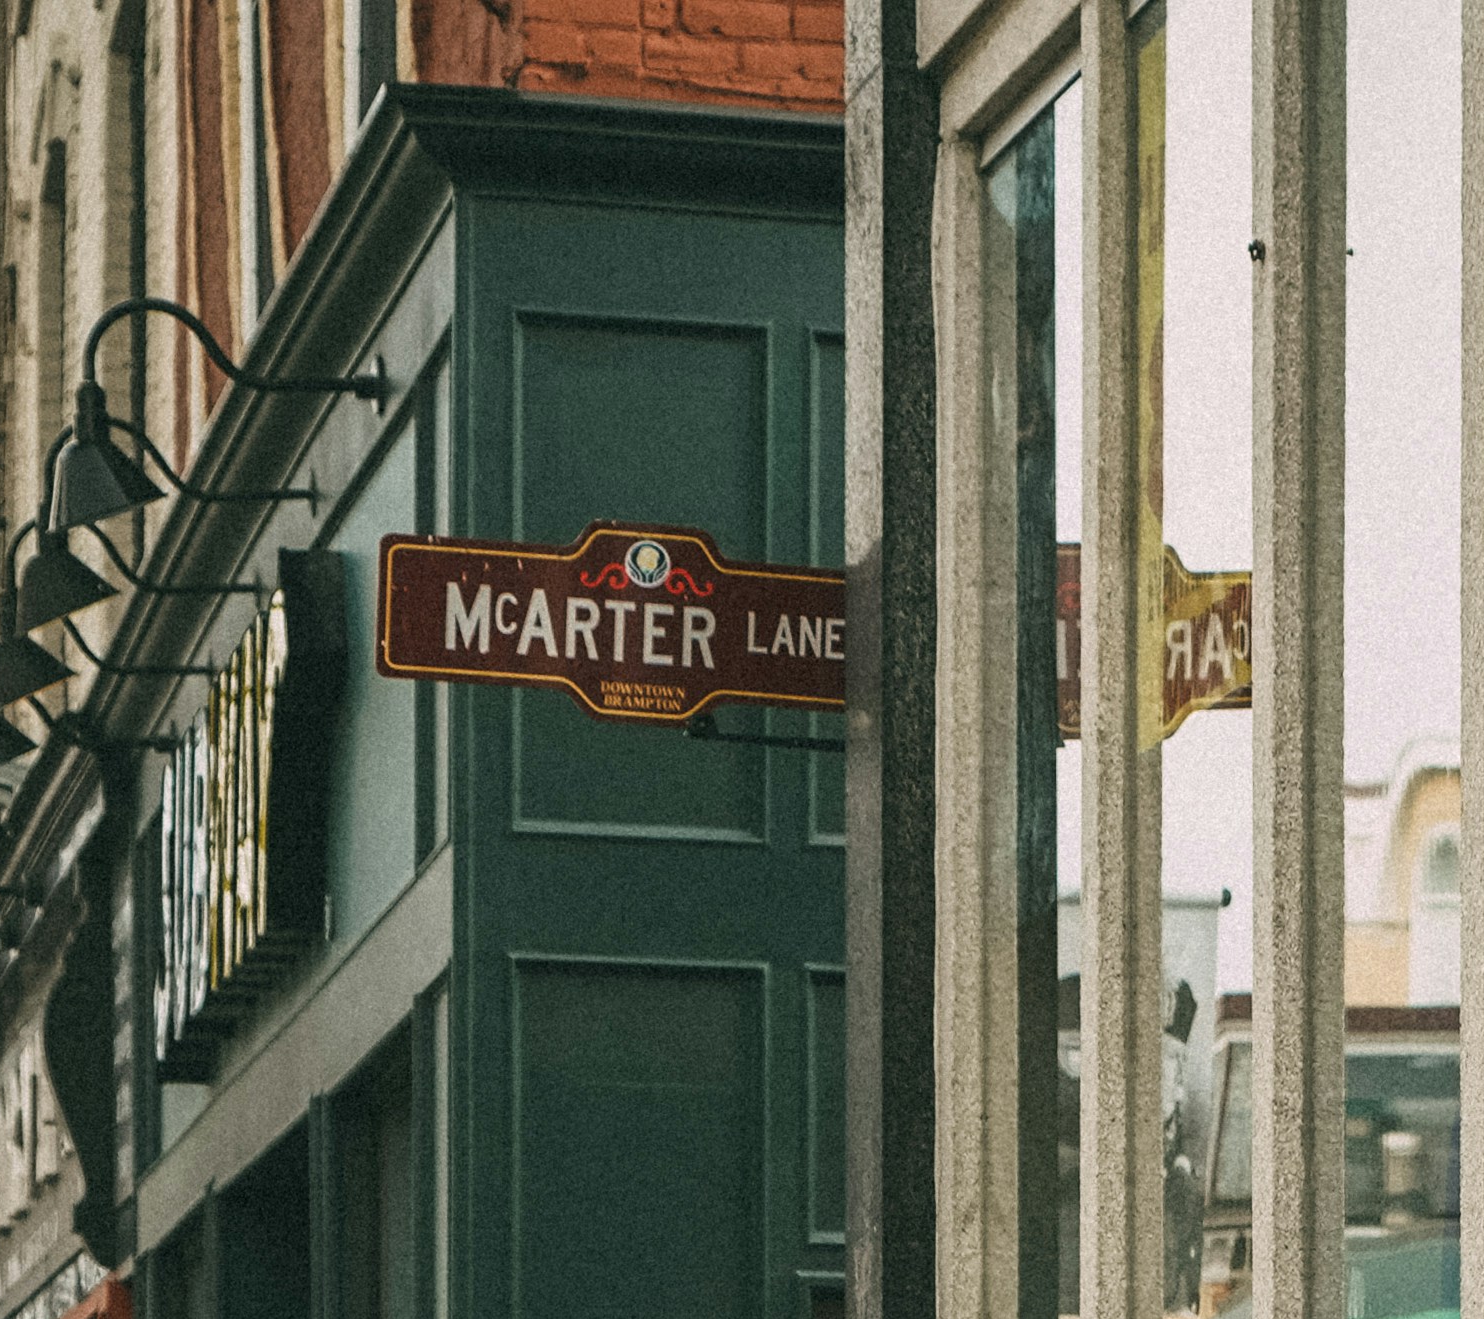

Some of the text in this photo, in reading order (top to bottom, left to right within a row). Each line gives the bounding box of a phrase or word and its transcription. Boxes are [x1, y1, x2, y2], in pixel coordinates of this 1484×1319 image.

[445, 581, 845, 670] McARTER LANE
[600, 680, 685, 699] DOWNTOWN
[604, 694, 681, 711] BRAMPTON
